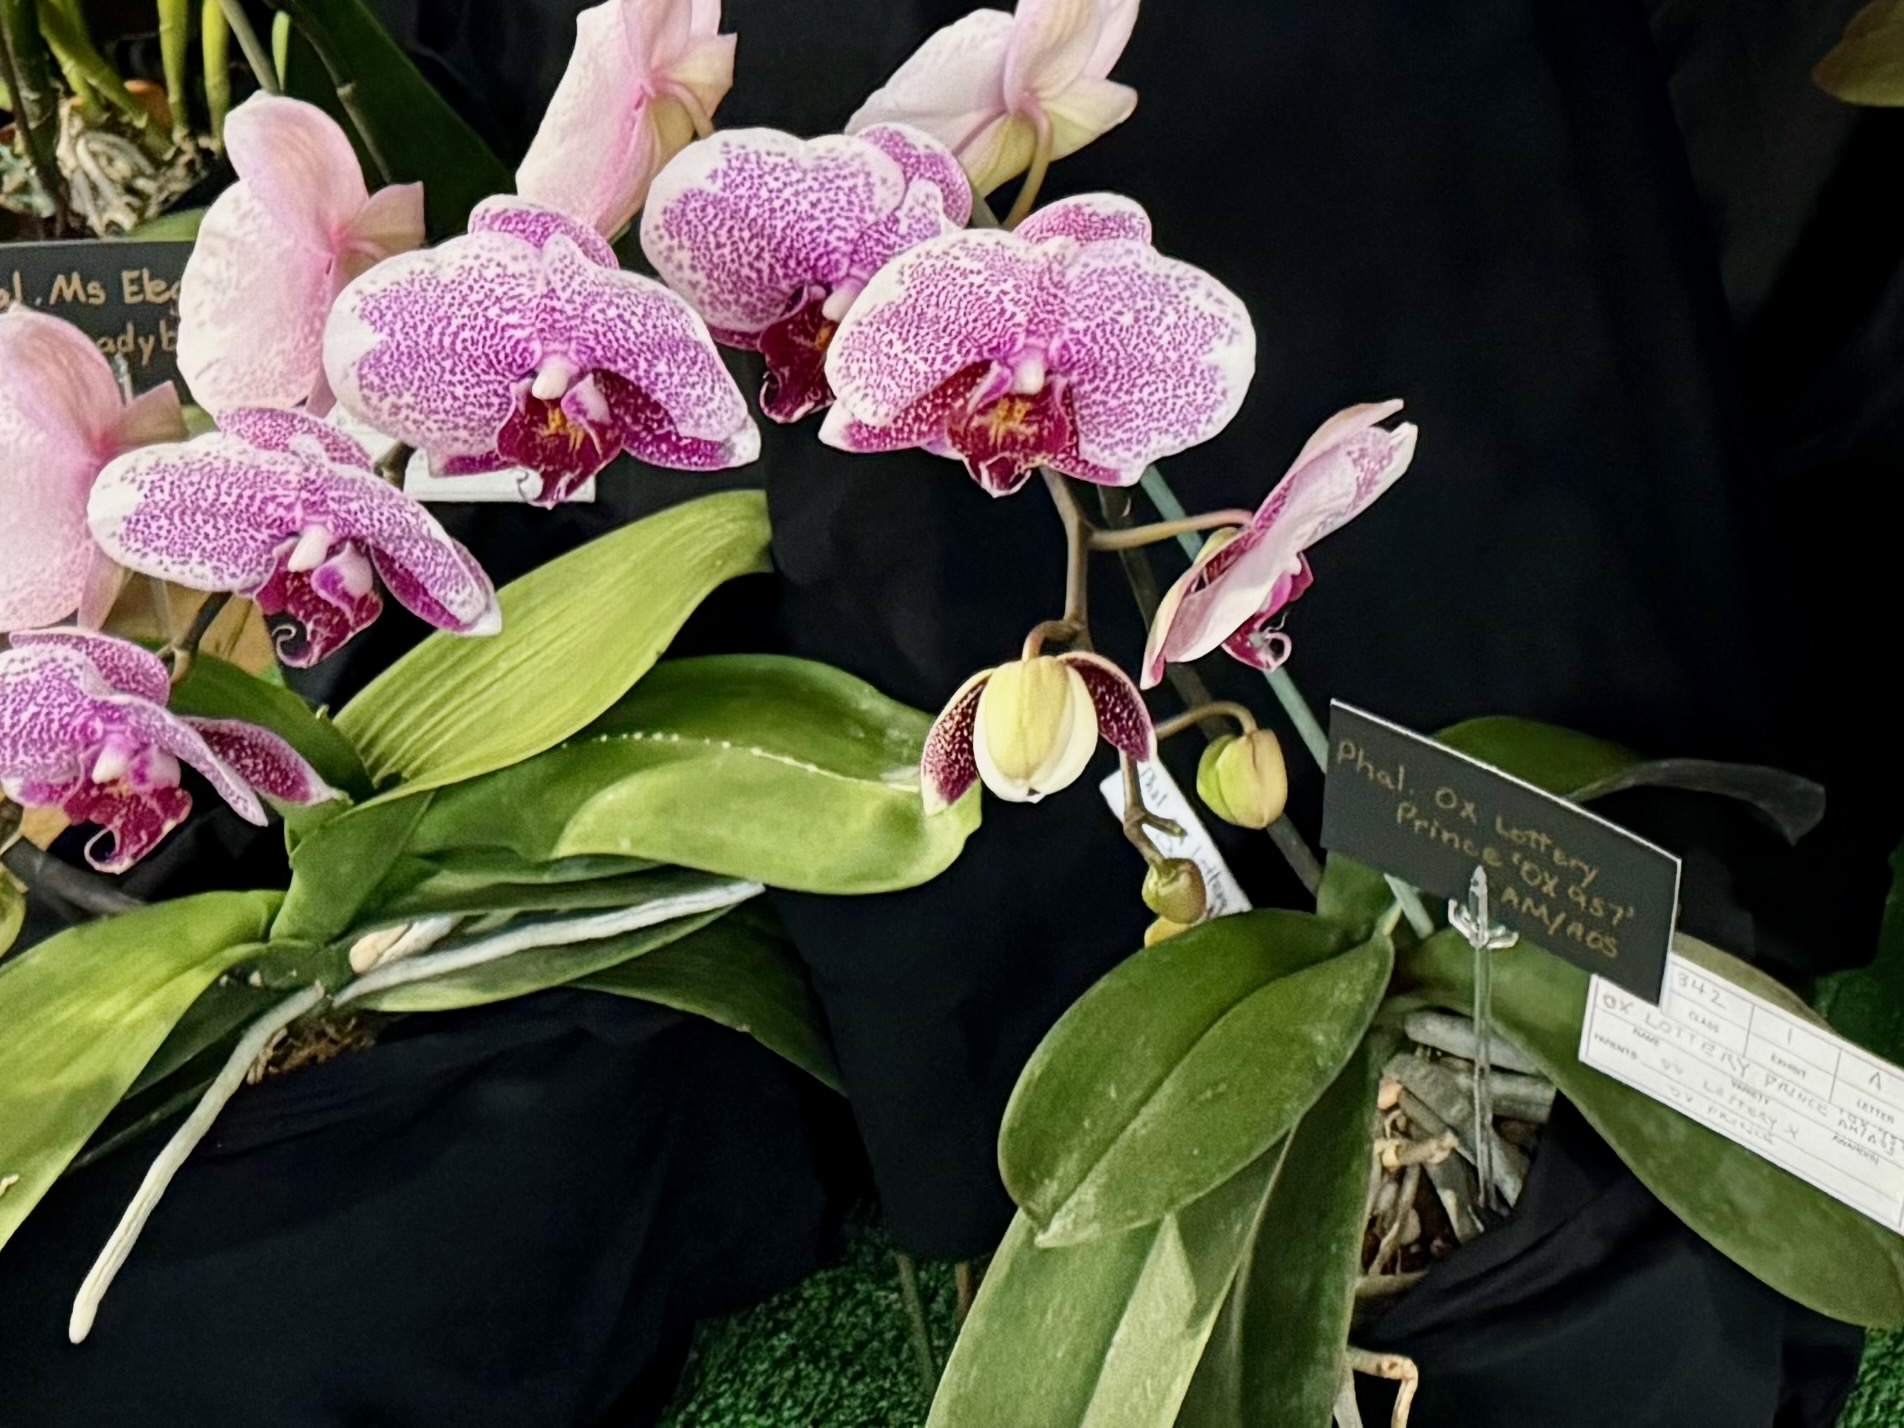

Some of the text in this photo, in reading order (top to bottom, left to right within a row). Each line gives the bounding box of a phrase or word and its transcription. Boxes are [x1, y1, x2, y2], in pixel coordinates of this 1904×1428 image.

[50, 270, 108, 305] Ms
[97, 319, 177, 367] adyb
[1337, 740, 1414, 794] Phal.
[1495, 815, 1599, 889] Lottery
[1396, 800, 1504, 867] Prince
